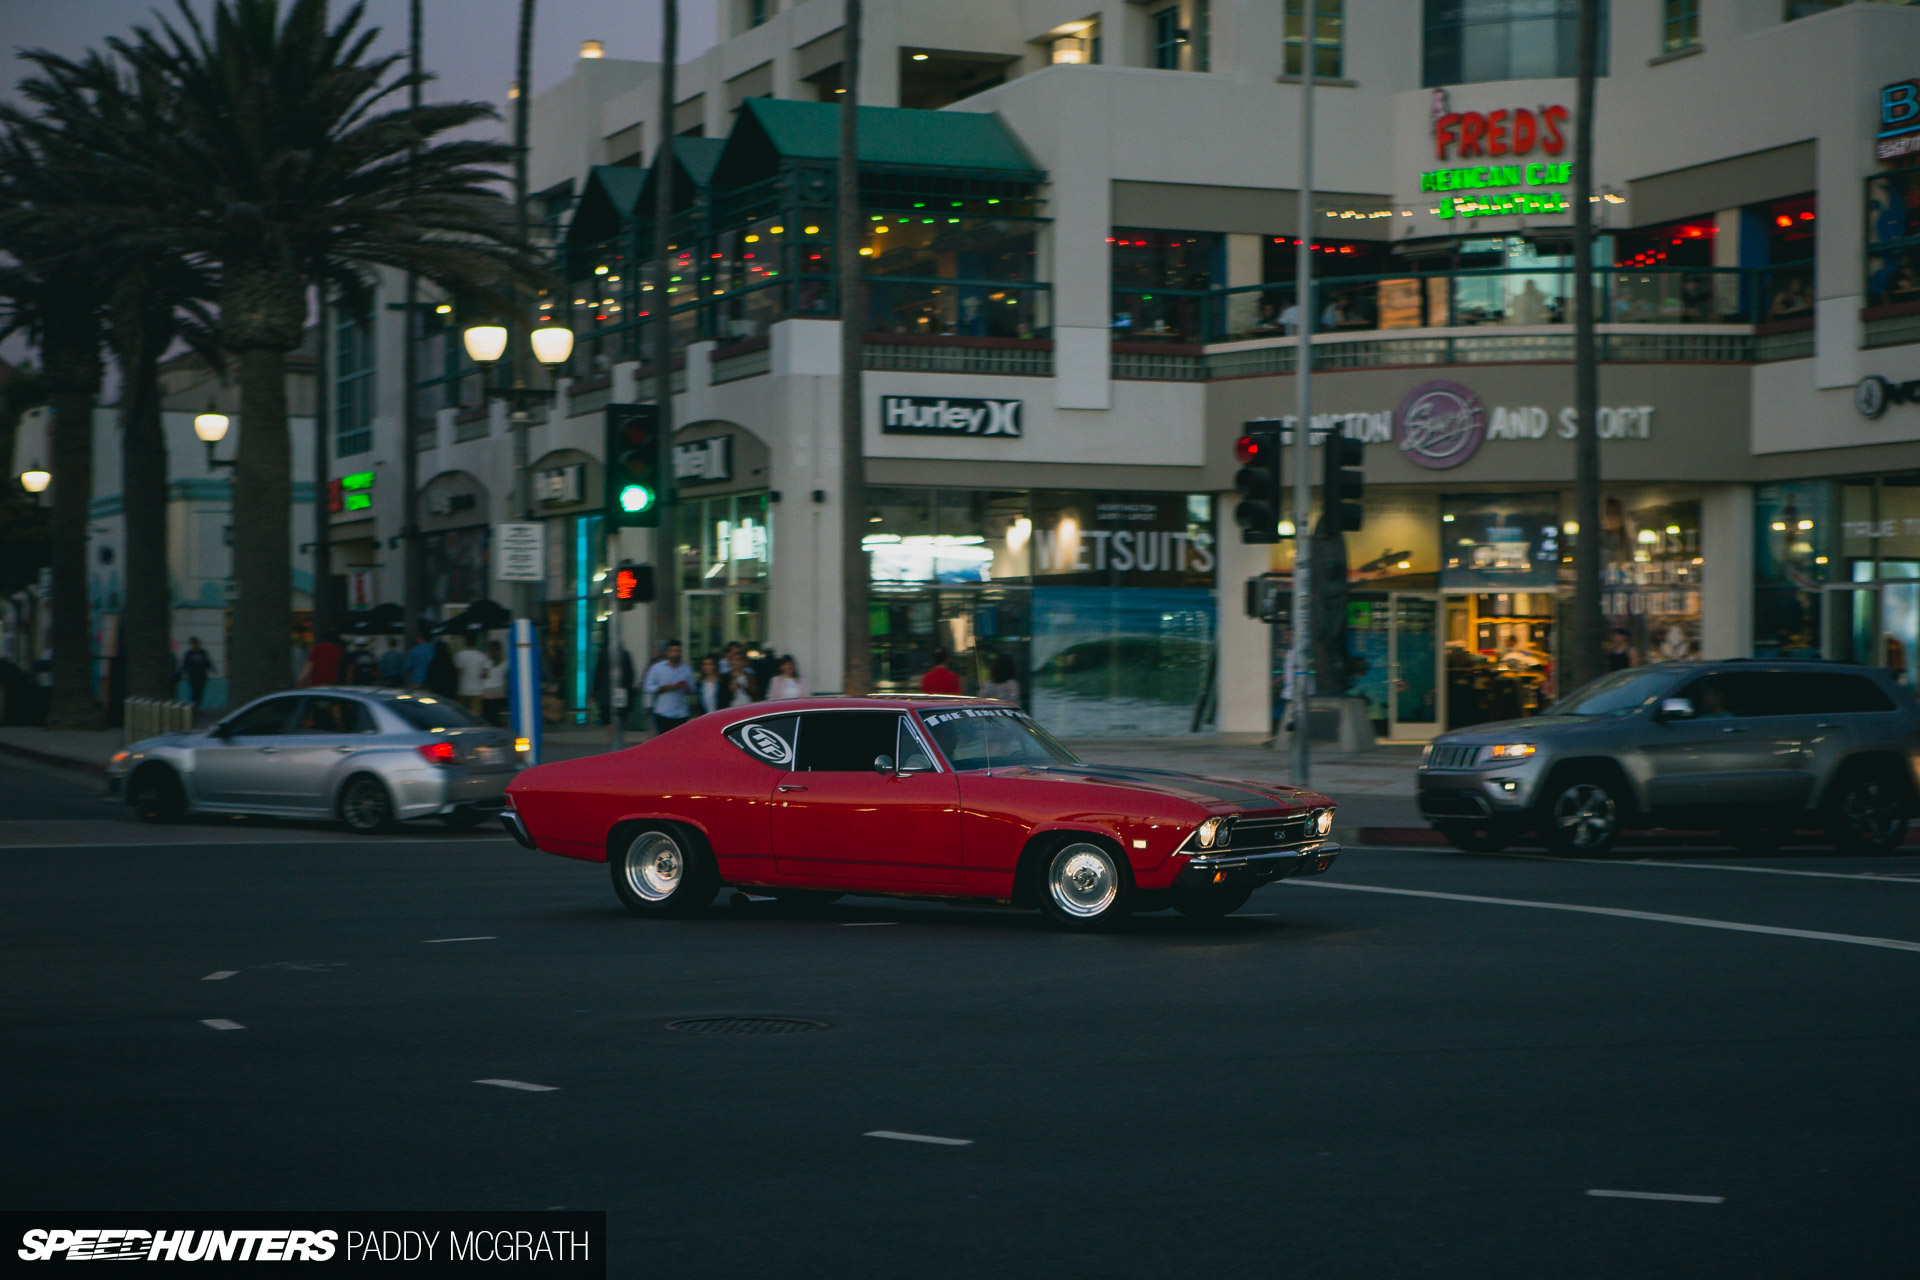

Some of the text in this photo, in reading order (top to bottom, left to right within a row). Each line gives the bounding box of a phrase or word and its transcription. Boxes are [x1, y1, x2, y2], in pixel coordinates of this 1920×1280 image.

[886, 398, 988, 434] Hurley
[1487, 406, 1550, 440] AND
[1556, 406, 1656, 439] SORT
[1034, 528, 1217, 573] WETSUITS
[752, 729, 786, 758] TTP
